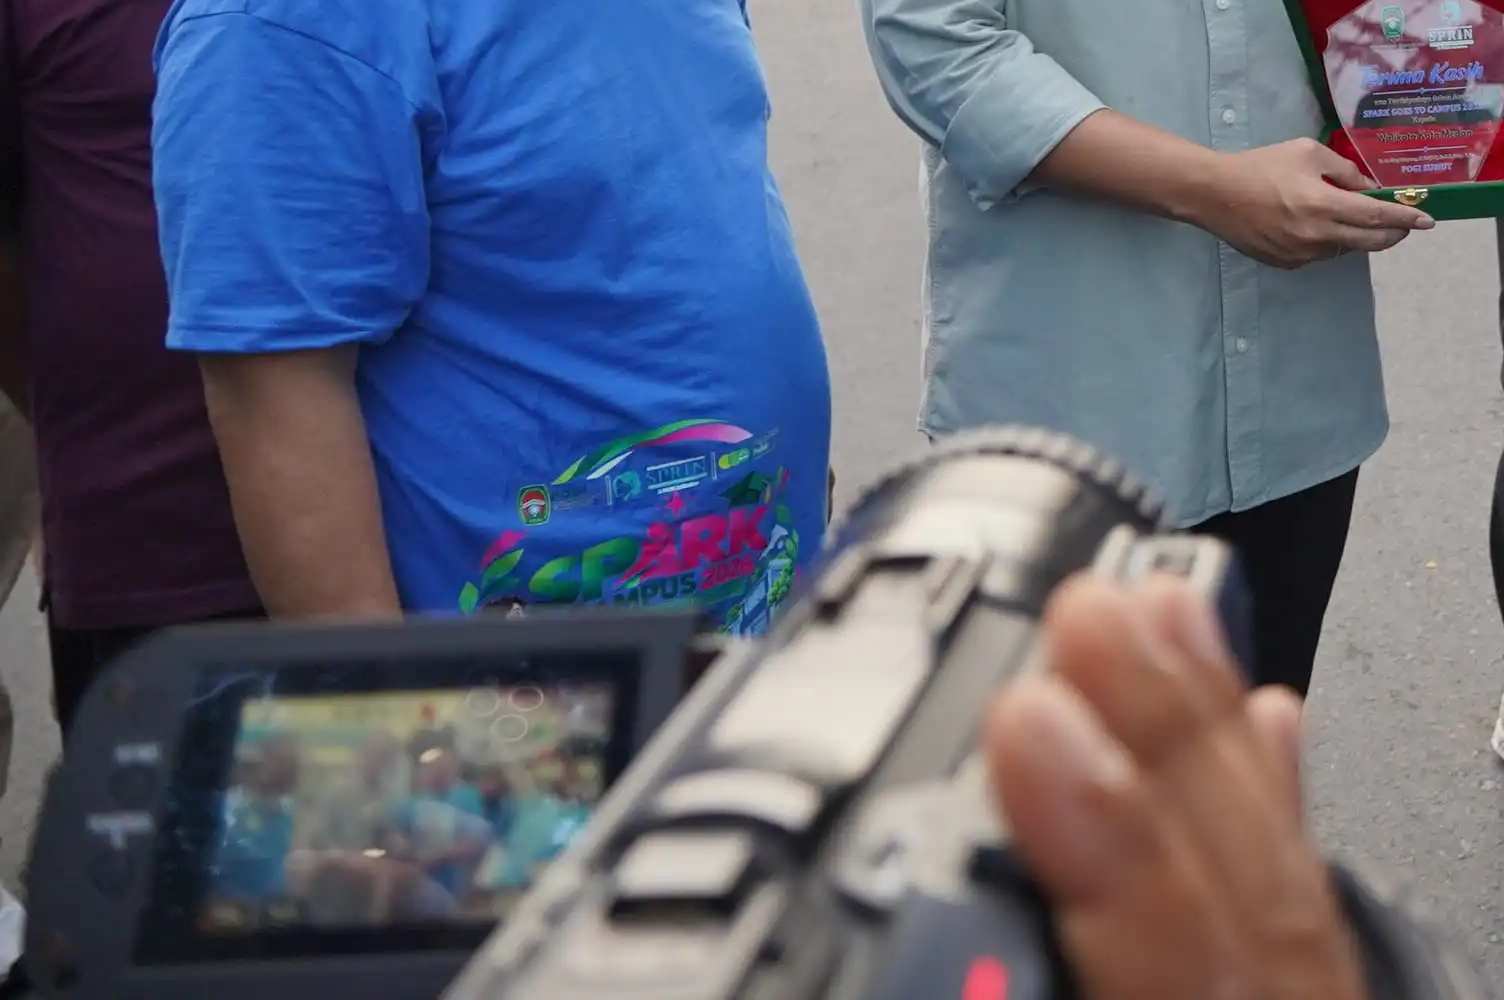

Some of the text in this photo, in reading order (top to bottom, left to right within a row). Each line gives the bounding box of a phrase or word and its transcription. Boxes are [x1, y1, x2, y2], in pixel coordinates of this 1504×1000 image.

[1428, 28, 1473, 42] SPRIN
[1414, 106, 1426, 114] TO
[1427, 104, 1461, 113] CAMPUS
[645, 459, 707, 487] SPRIN
[612, 572, 697, 608] MPUS
